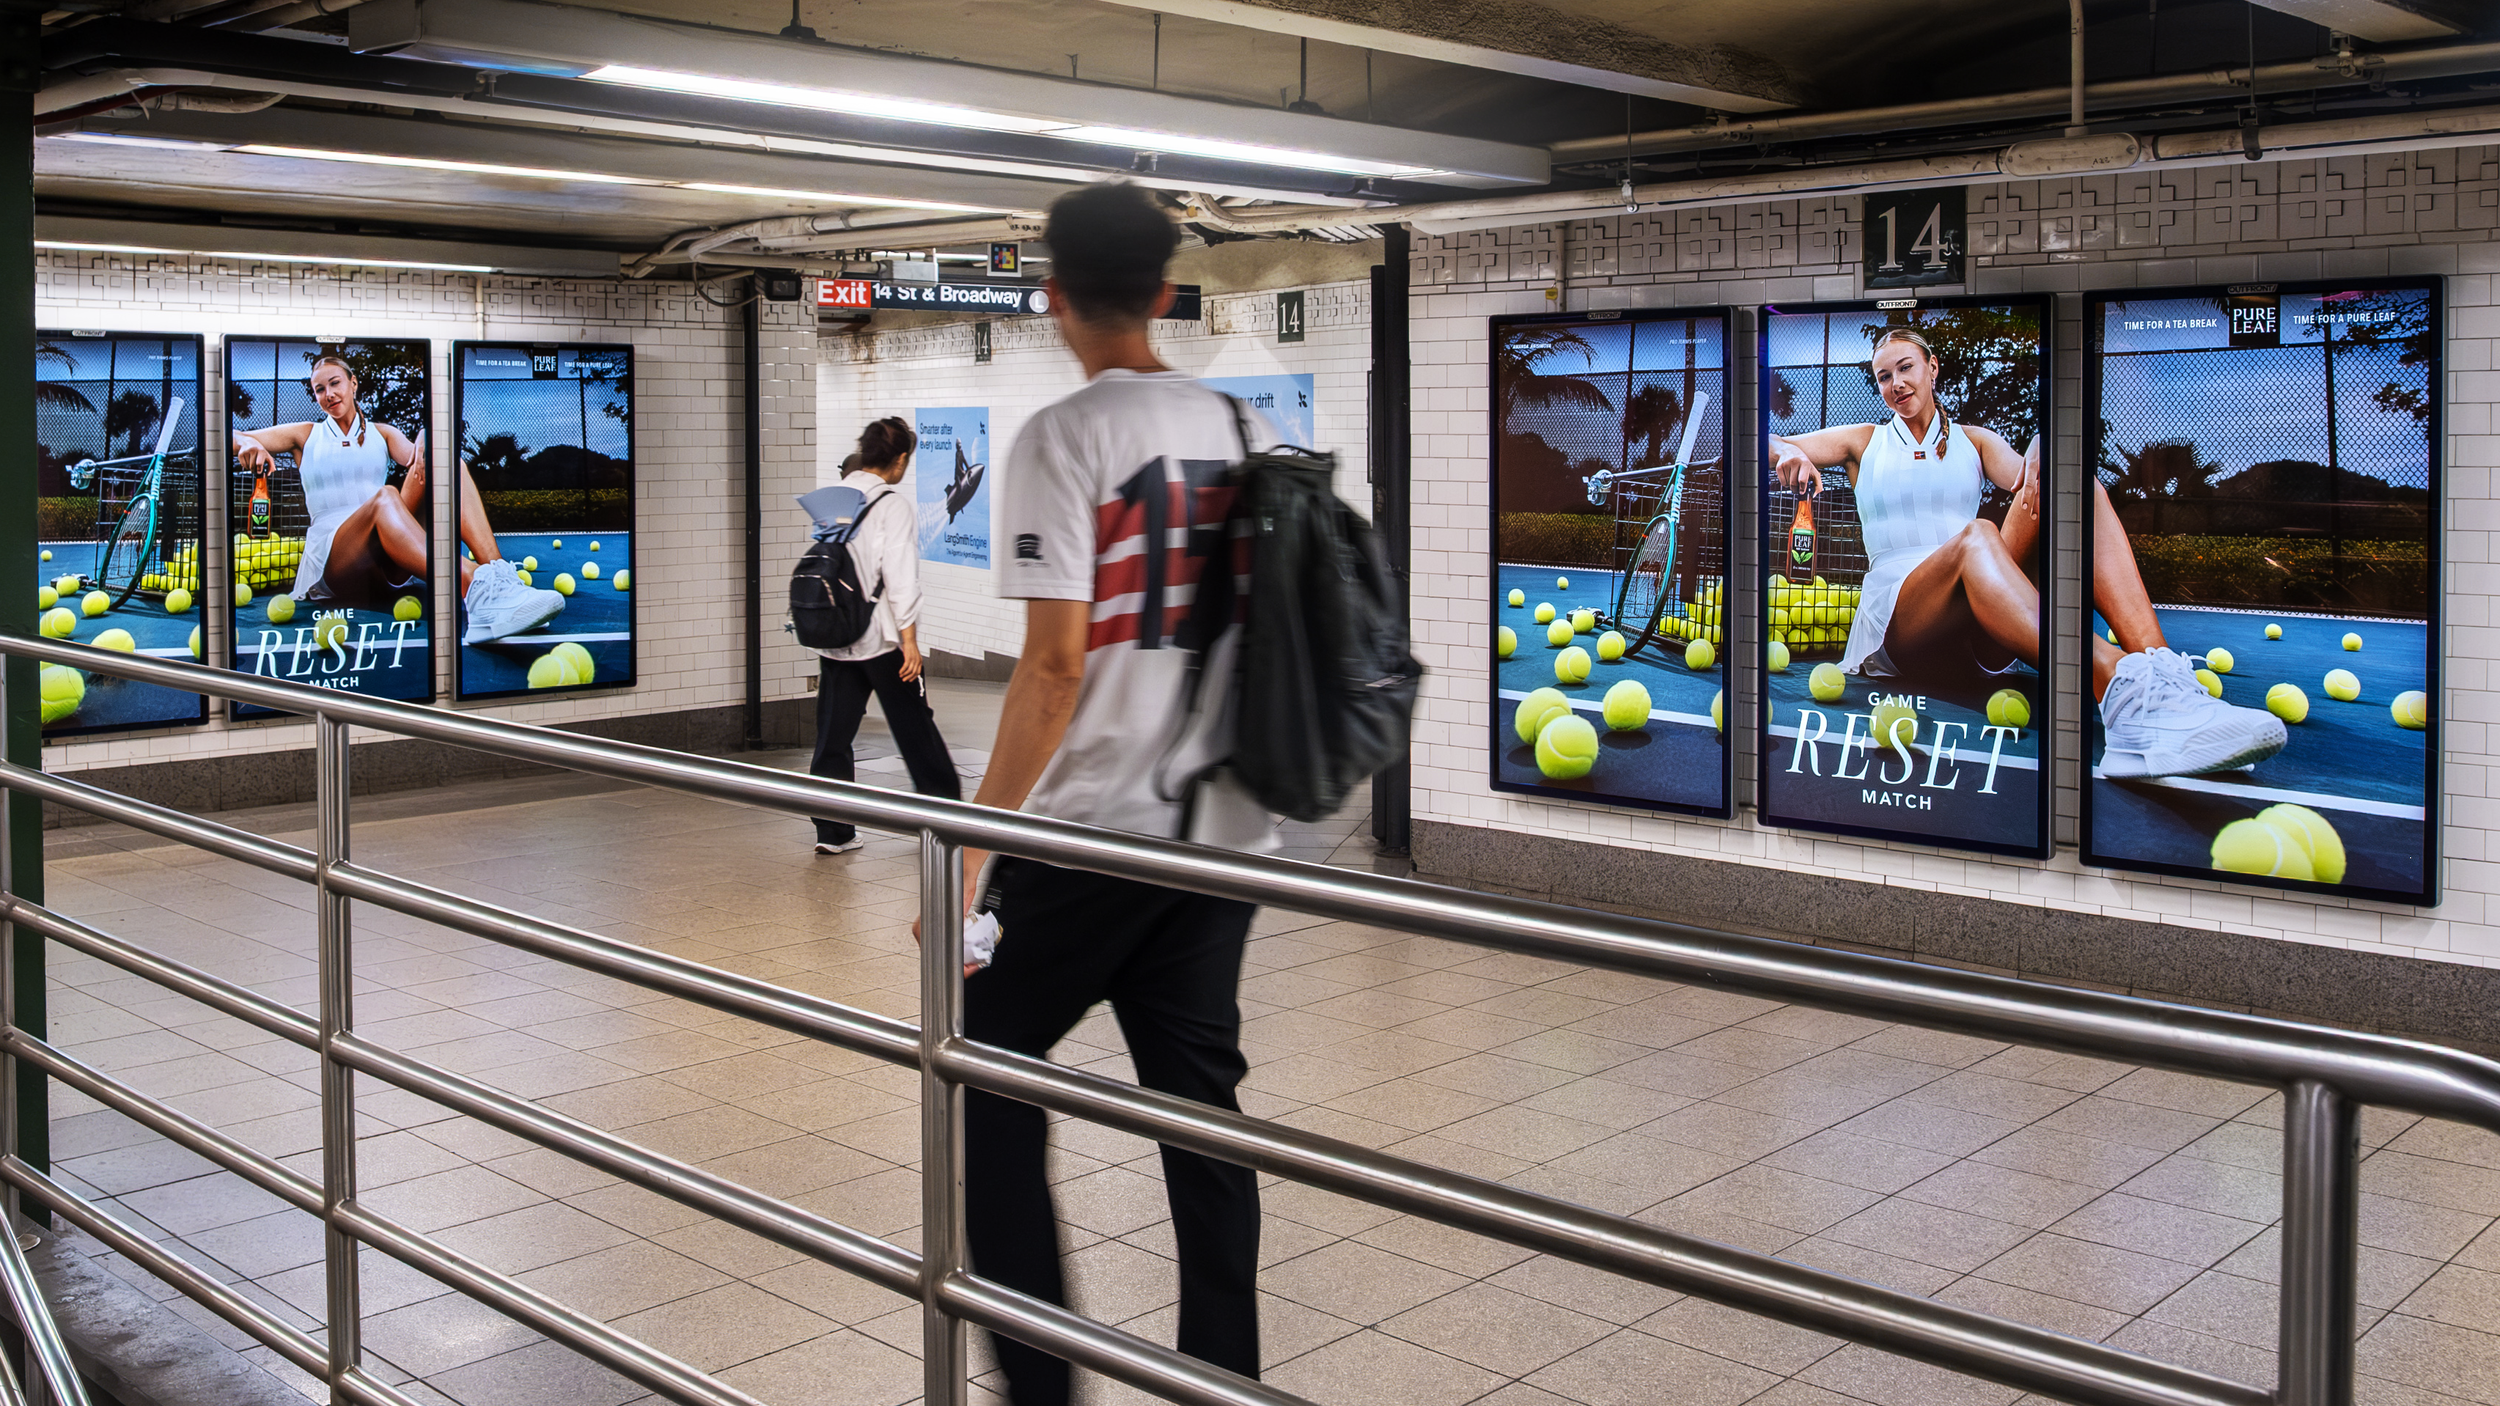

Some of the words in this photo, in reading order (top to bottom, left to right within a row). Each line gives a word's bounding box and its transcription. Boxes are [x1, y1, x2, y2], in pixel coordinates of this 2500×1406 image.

[1878, 202, 1949, 270] 14
[817, 280, 867, 304] Exit
[872, 283, 893, 299] 14
[897, 286, 918, 301] St
[921, 287, 936, 301] &
[940, 286, 1023, 308] Broadway
[1034, 295, 1044, 309] L
[1280, 301, 1300, 334] 14
[2233, 307, 2276, 321] PURE
[2293, 315, 2315, 324] TIME
[2318, 314, 2336, 323] FOR
[2337, 314, 2344, 323] A
[2347, 313, 2371, 322] PURE
[2374, 311, 2396, 322] LEAF
[2124, 321, 2144, 331] TIME
[2146, 320, 2163, 330] FOR
[2165, 320, 2171, 329] A
[2172, 319, 2187, 329] TEA
[2190, 318, 2217, 328] BREAK
[976, 330, 989, 355] 14
[534, 355, 557, 364] PURE
[1255, 393, 1275, 408] drift
[920, 423, 940, 435] Smarter
[940, 423, 953, 435] after
[920, 440, 934, 453] every
[934, 439, 952, 450] launch
[944, 531, 970, 546] LangSmith
[311, 608, 354, 621] GAME
[254, 620, 415, 678] RESET
[308, 676, 360, 690] MATCH
[1867, 691, 1927, 710] GAME
[1785, 708, 2020, 795] RESET
[1861, 789, 1932, 811] MATCH
